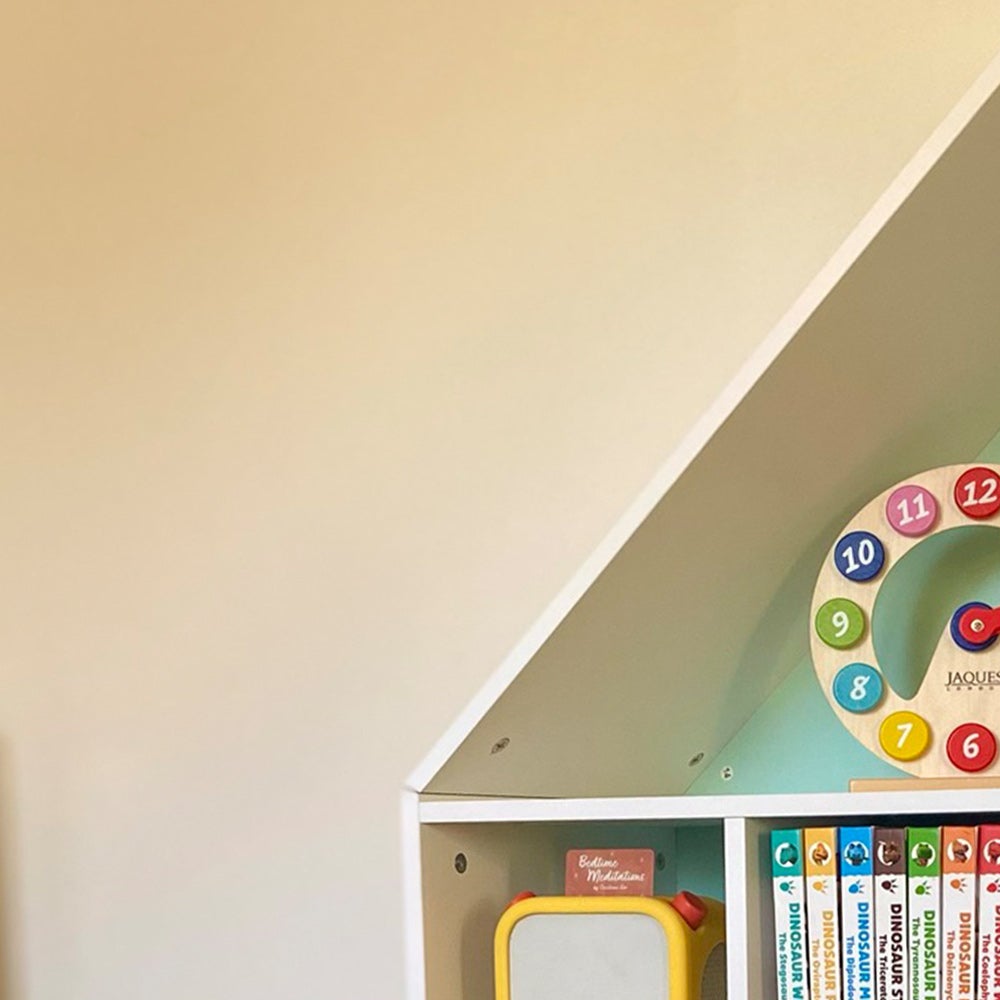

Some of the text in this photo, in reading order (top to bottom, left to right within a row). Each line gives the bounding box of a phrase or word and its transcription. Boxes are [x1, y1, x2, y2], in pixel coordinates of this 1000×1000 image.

[962, 478, 998, 508] 12
[896, 492, 930, 527] 11
[841, 539, 876, 575] 10
[831, 611, 850, 638] 9
[850, 675, 870, 699] 8
[896, 723, 914, 748] 7
[962, 733, 980, 759] 6
[579, 855, 618, 868] Bedtime
[587, 869, 645, 883] Meditations
[912, 917, 920, 936] The
[779, 932, 787, 951] The
[789, 903, 803, 983] DINOSAUR
[812, 939, 820, 957] The
[823, 911, 836, 990] DINOSAUR
[857, 902, 870, 982] DINOSAUR
[879, 935, 887, 953] The
[890, 904, 903, 984] DINOSAUR
[924, 910, 936, 991] DINOSAUR
[947, 931, 955, 950] The
[958, 912, 971, 993] DINOSAUR
[982, 934, 991, 953] The
